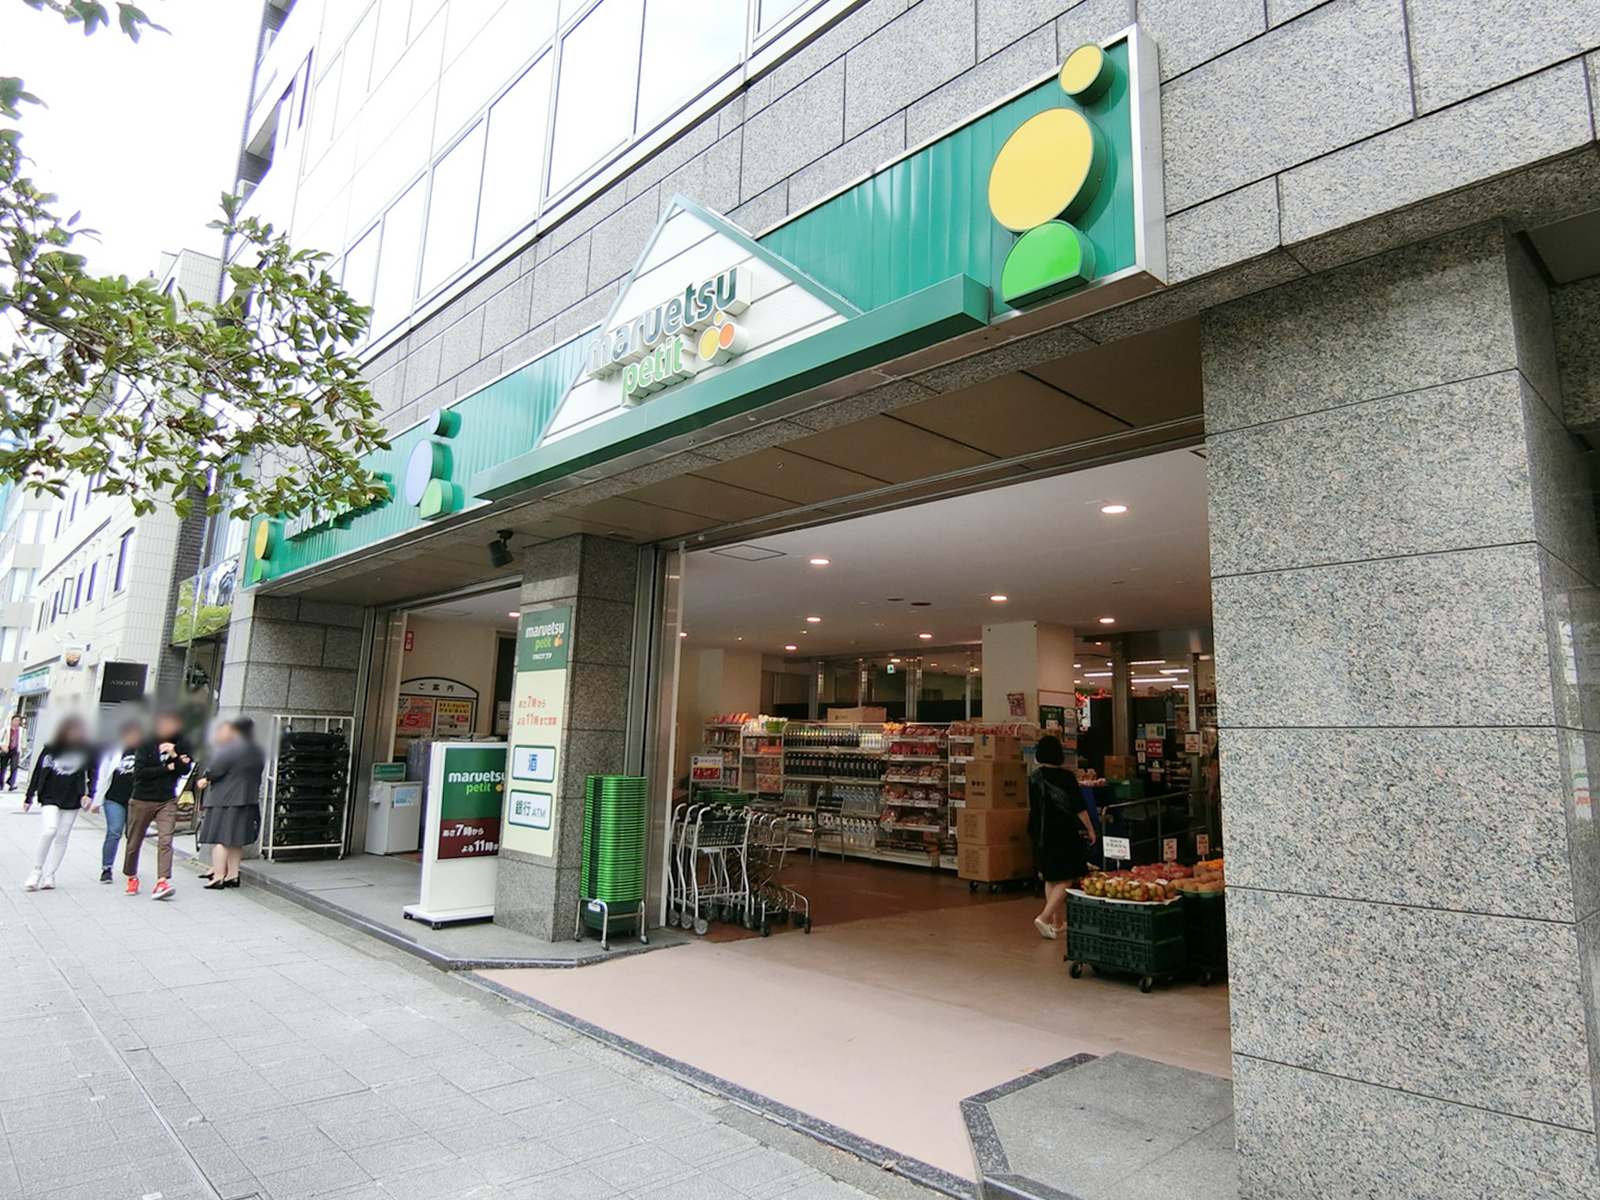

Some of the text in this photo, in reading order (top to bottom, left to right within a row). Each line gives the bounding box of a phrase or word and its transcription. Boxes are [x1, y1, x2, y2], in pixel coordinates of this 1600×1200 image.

[586, 267, 740, 376] maruetsu
[620, 335, 685, 408] petit
[525, 621, 565, 639] maruetsu
[534, 636, 552, 652] petit
[418, 682, 455, 692] ご案内
[518, 695, 547, 708] あさ7時から
[466, 782, 492, 796] petit
[515, 799, 546, 818] 銀行 ATM
[442, 823, 485, 837] あさ7時から
